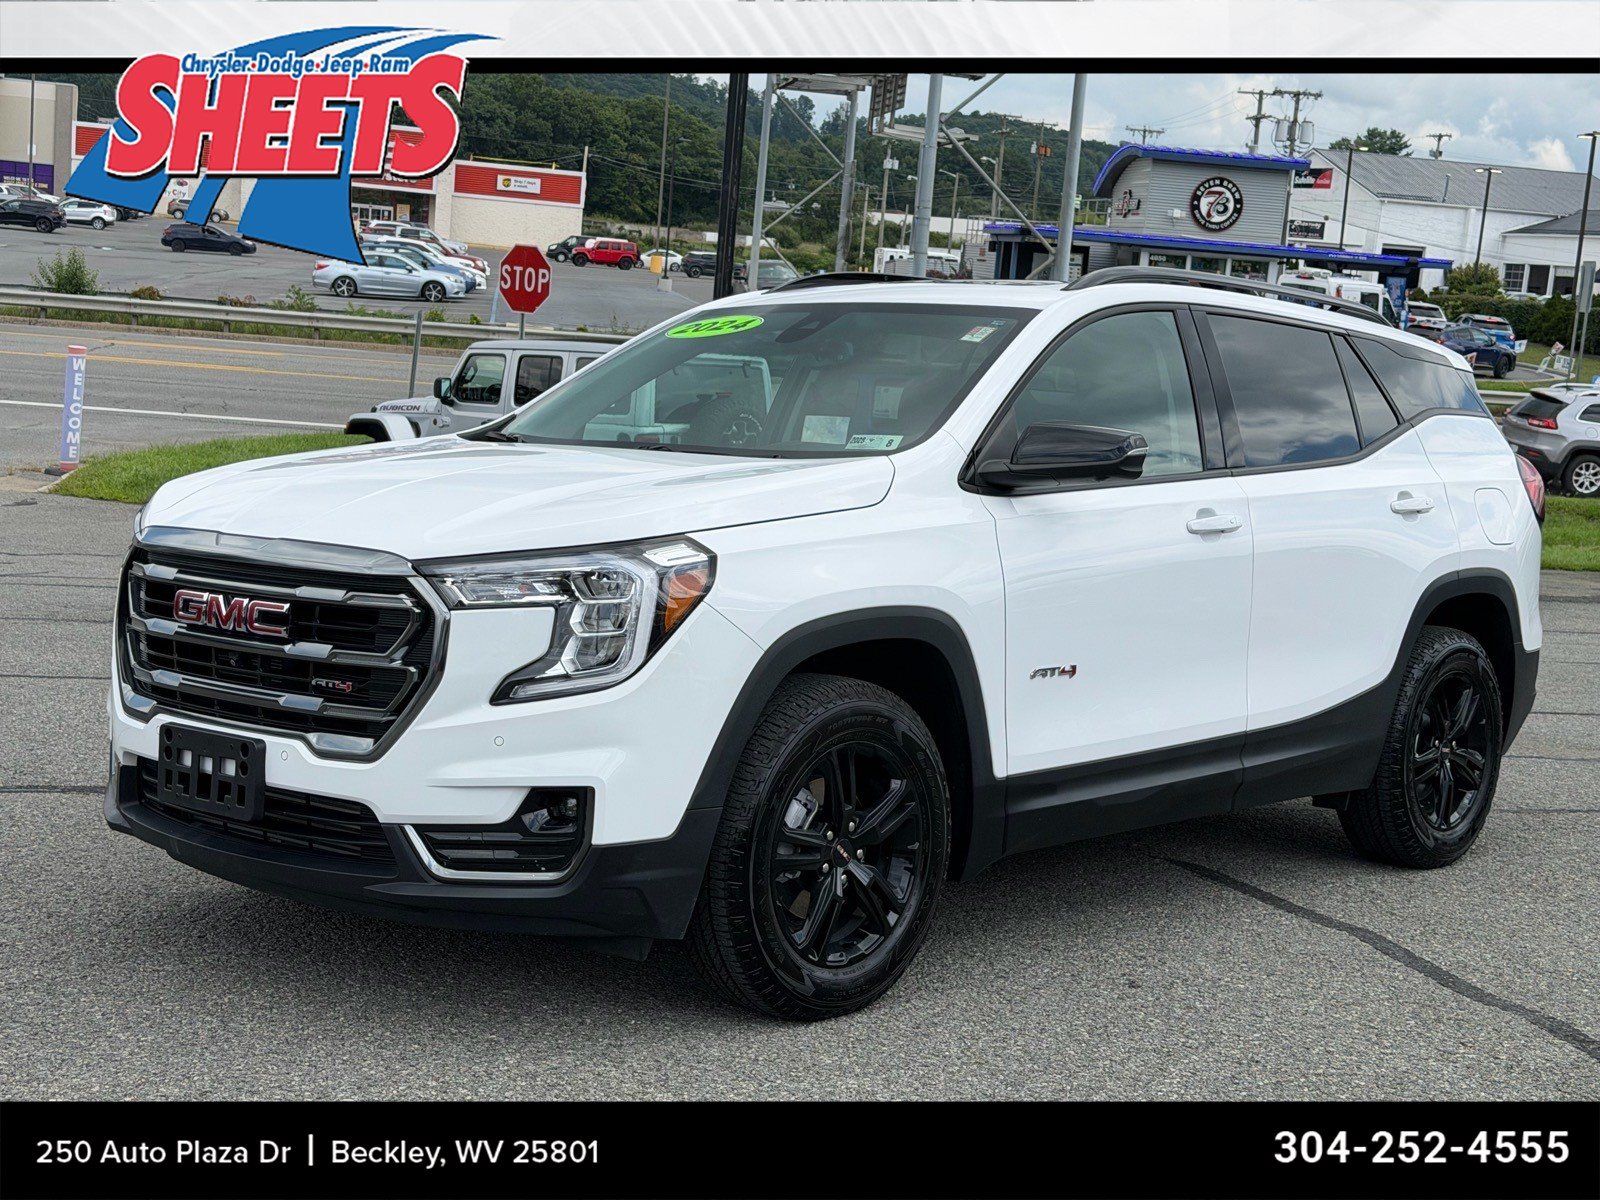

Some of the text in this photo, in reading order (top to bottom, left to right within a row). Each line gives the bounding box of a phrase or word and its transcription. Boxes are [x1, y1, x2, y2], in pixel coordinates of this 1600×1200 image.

[1196, 179, 1241, 199] SEVEN BREW
[501, 264, 549, 293] STOP
[672, 319, 758, 335] 2024
[66, 357, 87, 459] WELCOME
[379, 404, 421, 412] RUBICON
[173, 589, 290, 638] GMC
[1029, 664, 1077, 680] AT4
[311, 677, 353, 693] AT4
